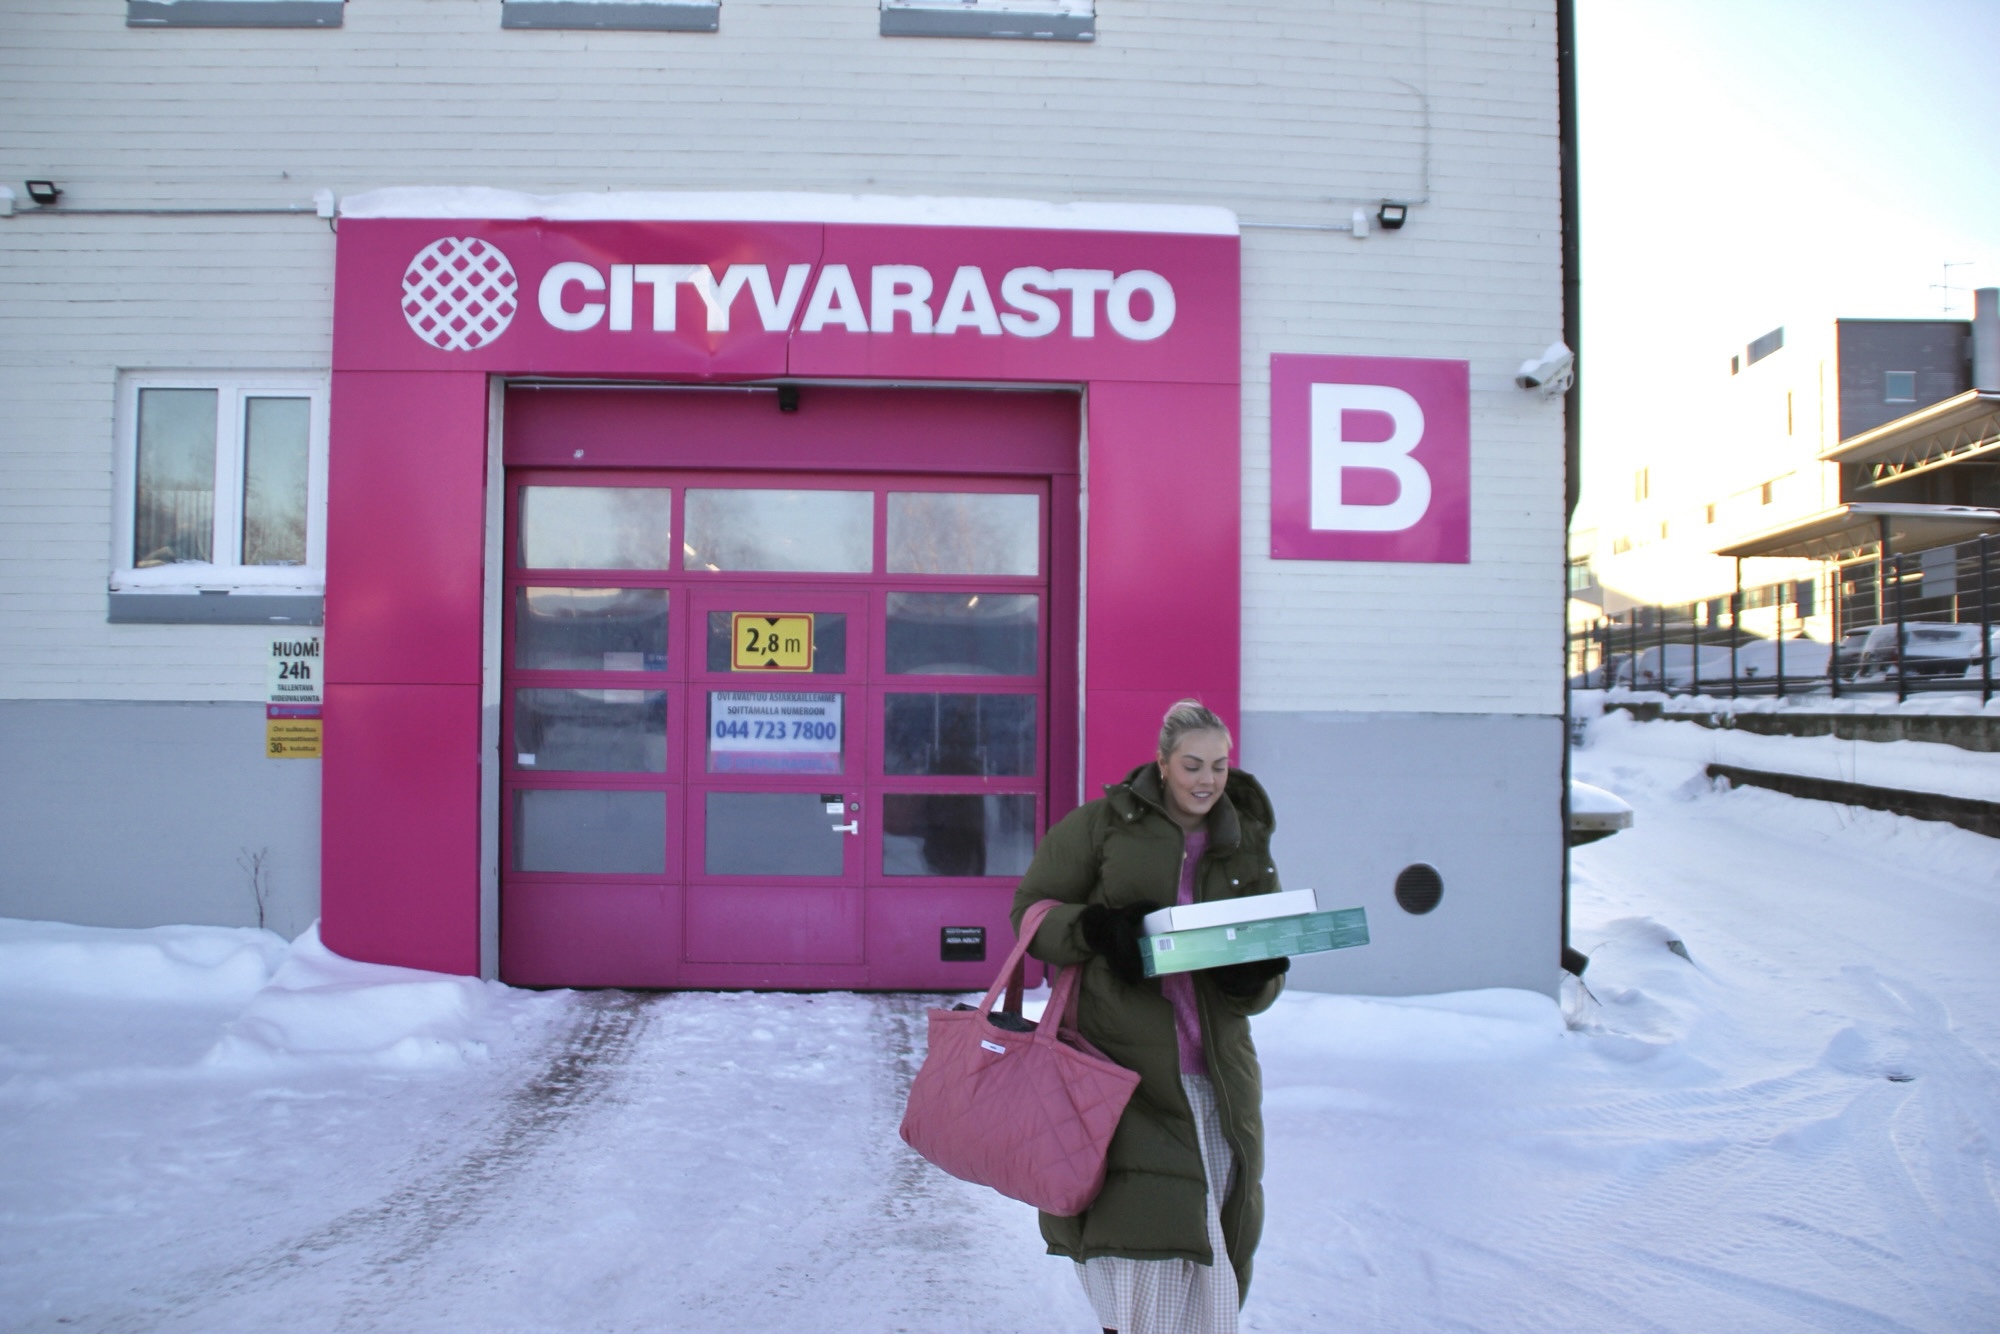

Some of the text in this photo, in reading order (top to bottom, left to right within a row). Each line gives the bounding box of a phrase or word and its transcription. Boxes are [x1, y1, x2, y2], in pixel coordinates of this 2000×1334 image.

[538, 261, 1176, 341] CITYVARASTO
[1311, 382, 1432, 532] B
[273, 641, 319, 657] HUOM!
[745, 627, 800, 656] 2,8 m
[279, 660, 310, 679] 24h
[717, 691, 731, 701] OVI
[727, 705, 825, 716] SOITTAMALLA NUMEROON
[716, 719, 836, 740] 044 723 7800
